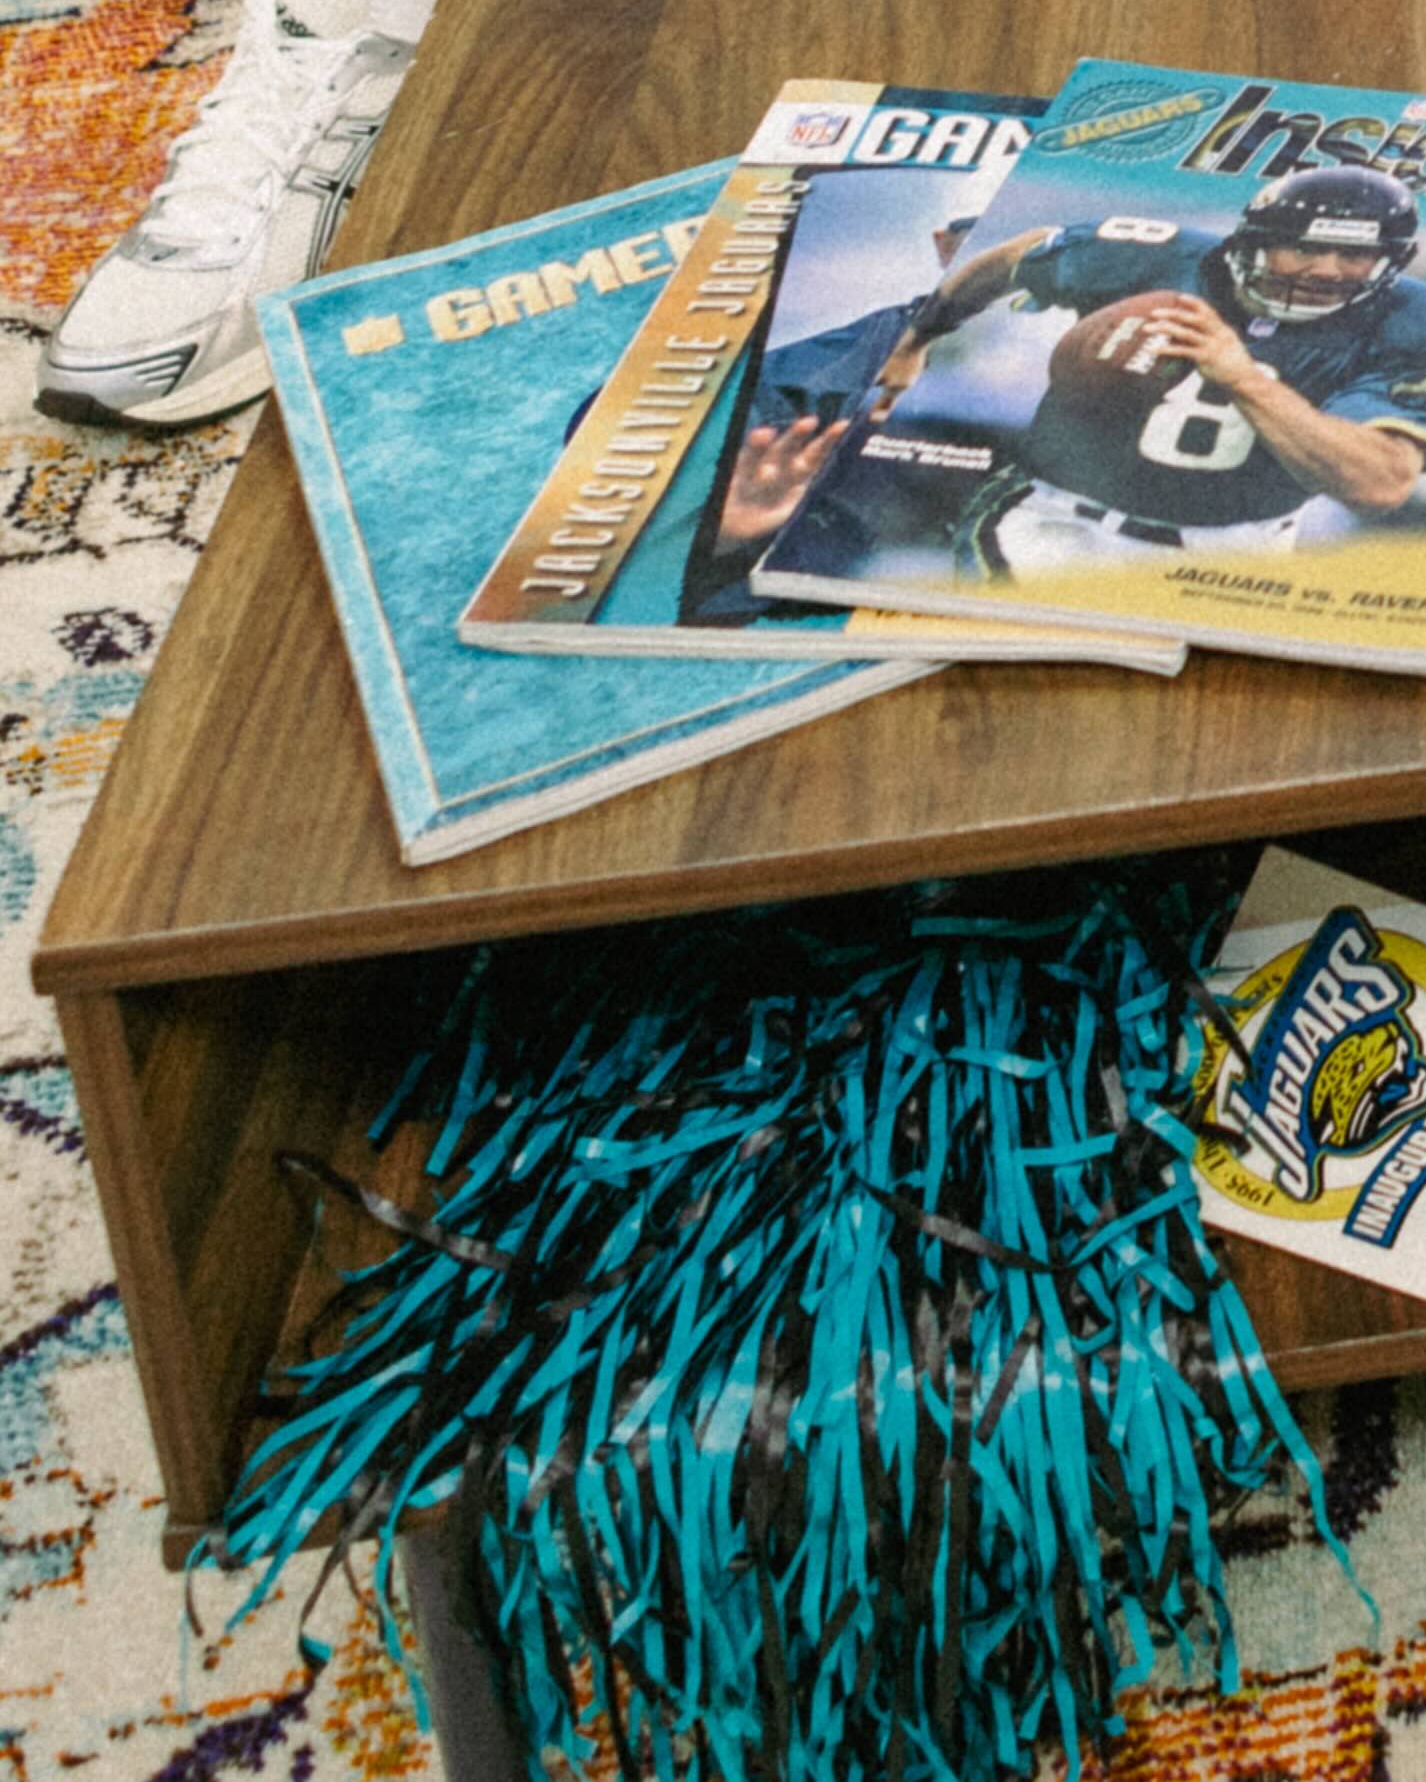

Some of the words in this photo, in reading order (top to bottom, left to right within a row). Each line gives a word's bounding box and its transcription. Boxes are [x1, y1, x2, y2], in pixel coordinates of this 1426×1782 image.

[1061, 94, 1205, 147] JAGUARS
[684, 172, 816, 317] JAGUARS
[519, 334, 729, 599] JACKSONVILLE
[1165, 563, 1295, 599] JAGUARS
[1216, 925, 1401, 1198] JAGUARS
